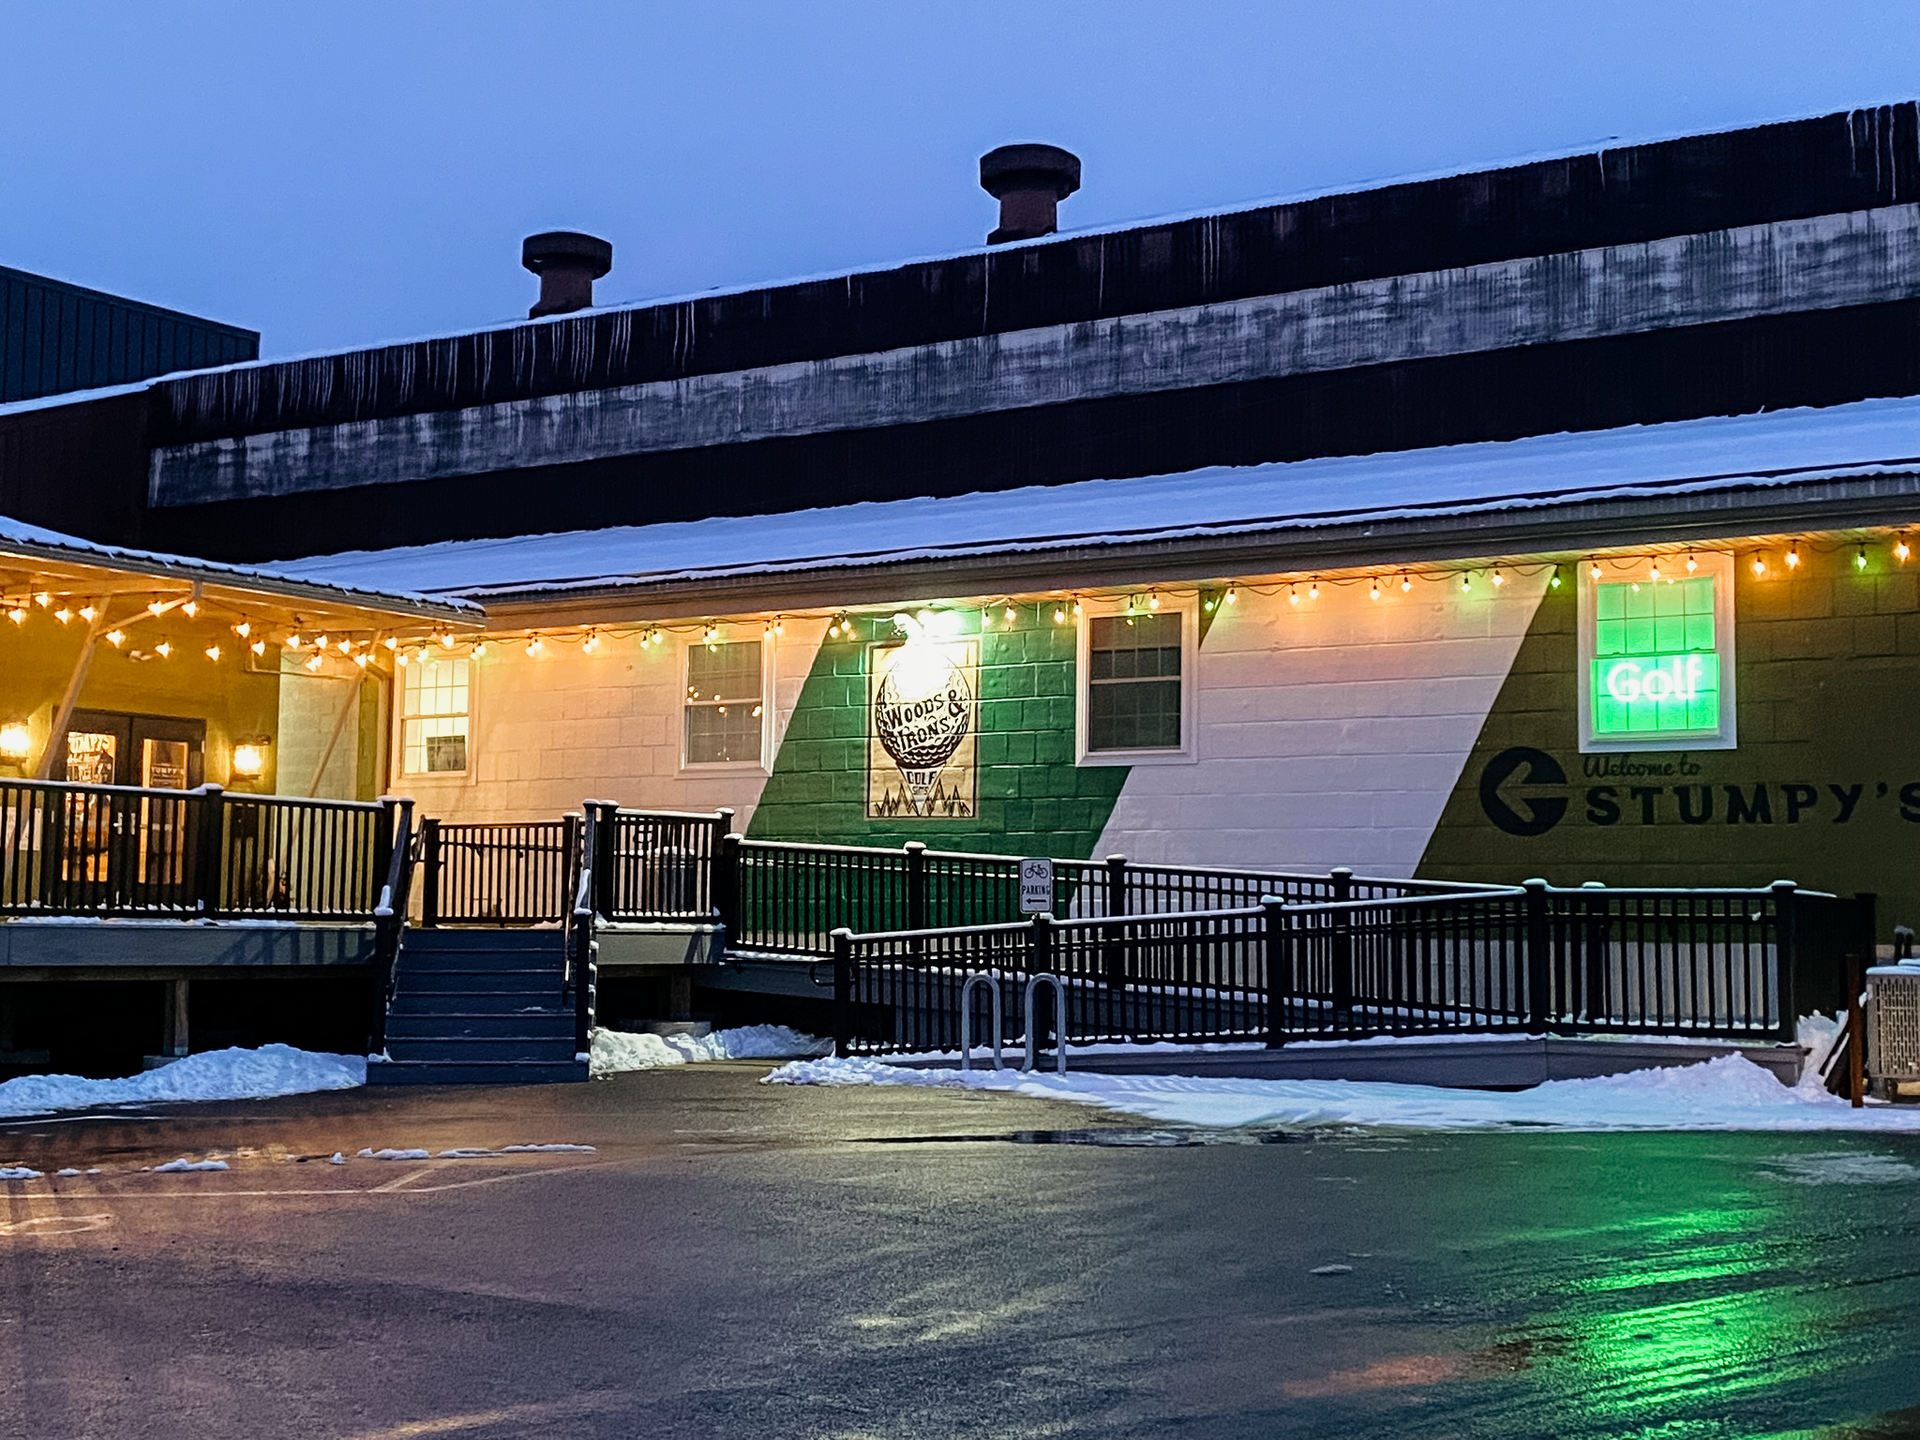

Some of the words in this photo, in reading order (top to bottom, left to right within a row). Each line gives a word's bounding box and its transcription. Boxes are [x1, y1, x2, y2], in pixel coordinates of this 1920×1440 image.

[1607, 655, 1703, 702] Golf
[885, 694, 944, 729] WOODS
[948, 690, 965, 717] &
[898, 716, 950, 750] IRONS
[906, 771, 937, 785] GOLF
[1584, 755, 1676, 777] Welcome
[1678, 753, 1701, 776] to
[1586, 782, 1920, 826] STUMPY'S
[1021, 885, 1050, 895] PARKING
